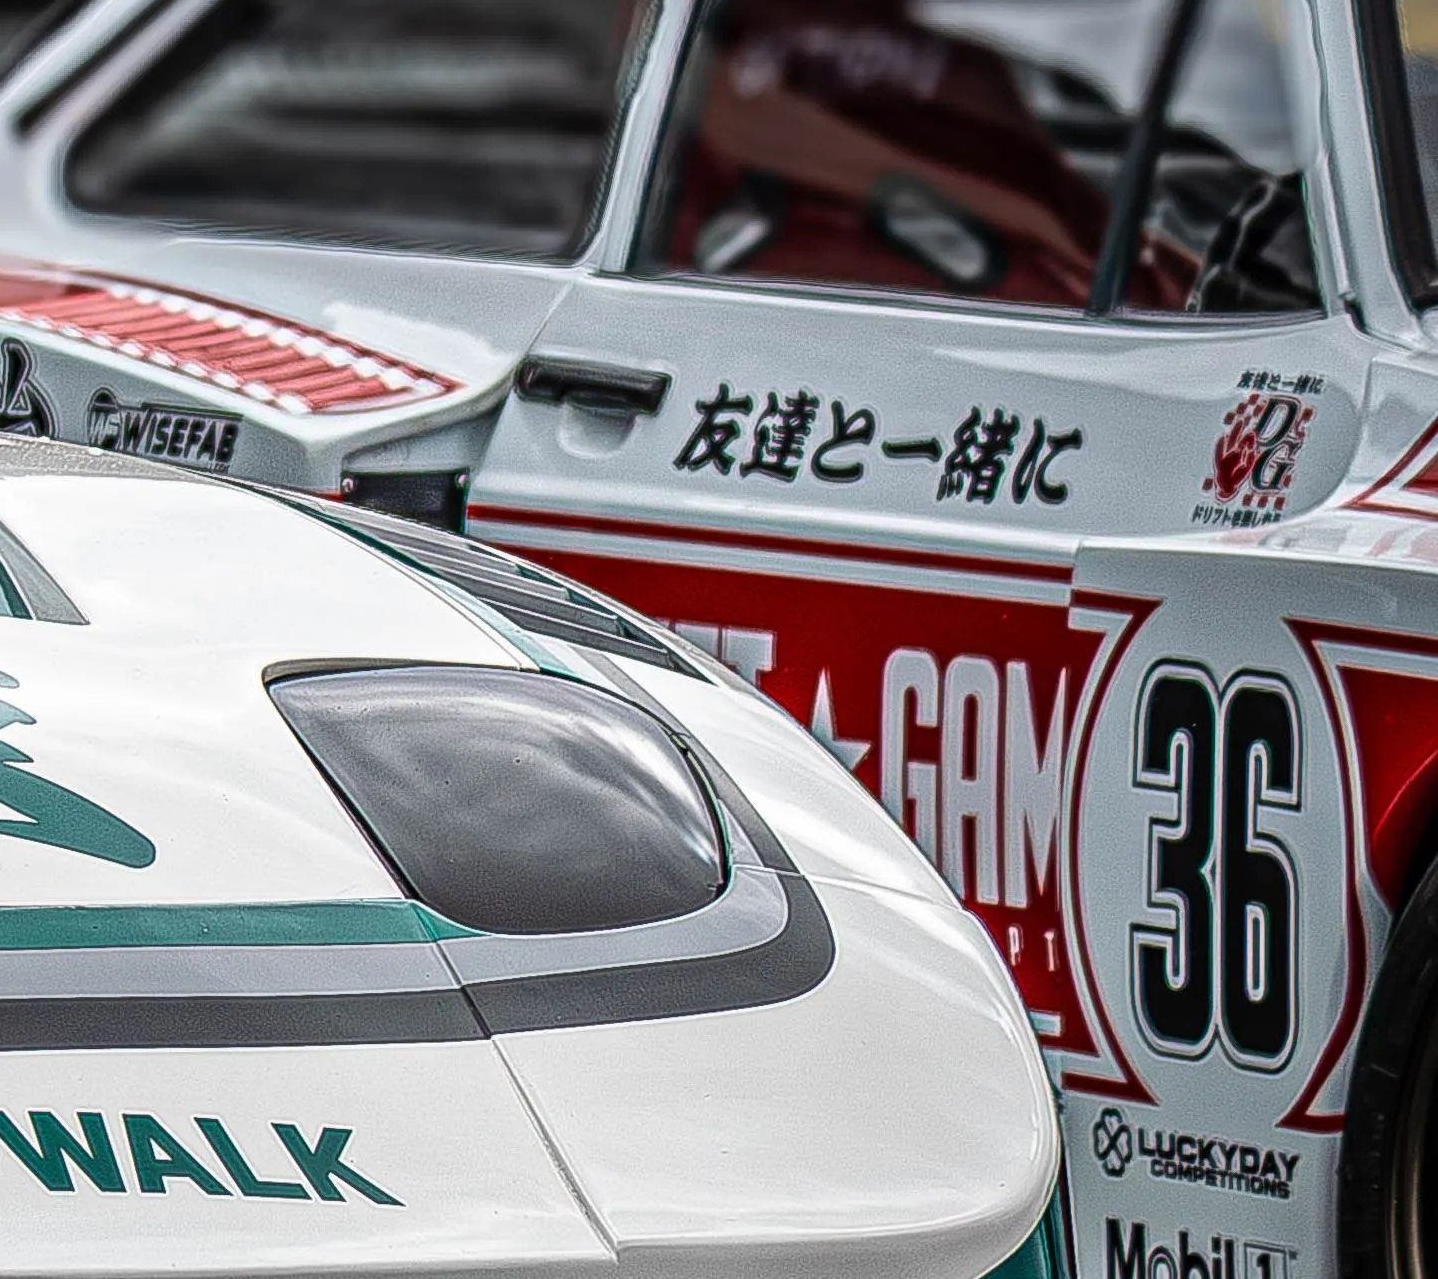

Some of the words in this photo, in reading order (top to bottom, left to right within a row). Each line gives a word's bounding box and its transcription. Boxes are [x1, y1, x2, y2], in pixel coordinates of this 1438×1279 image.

[120, 407, 239, 463] WISEFAB
[673, 383, 1083, 505] 友達と一緒に
[1132, 658, 1304, 1074] 36
[1137, 1126, 1301, 1182] LUCKYDAY
[1150, 1158, 1291, 1200] COMPETITIONS
